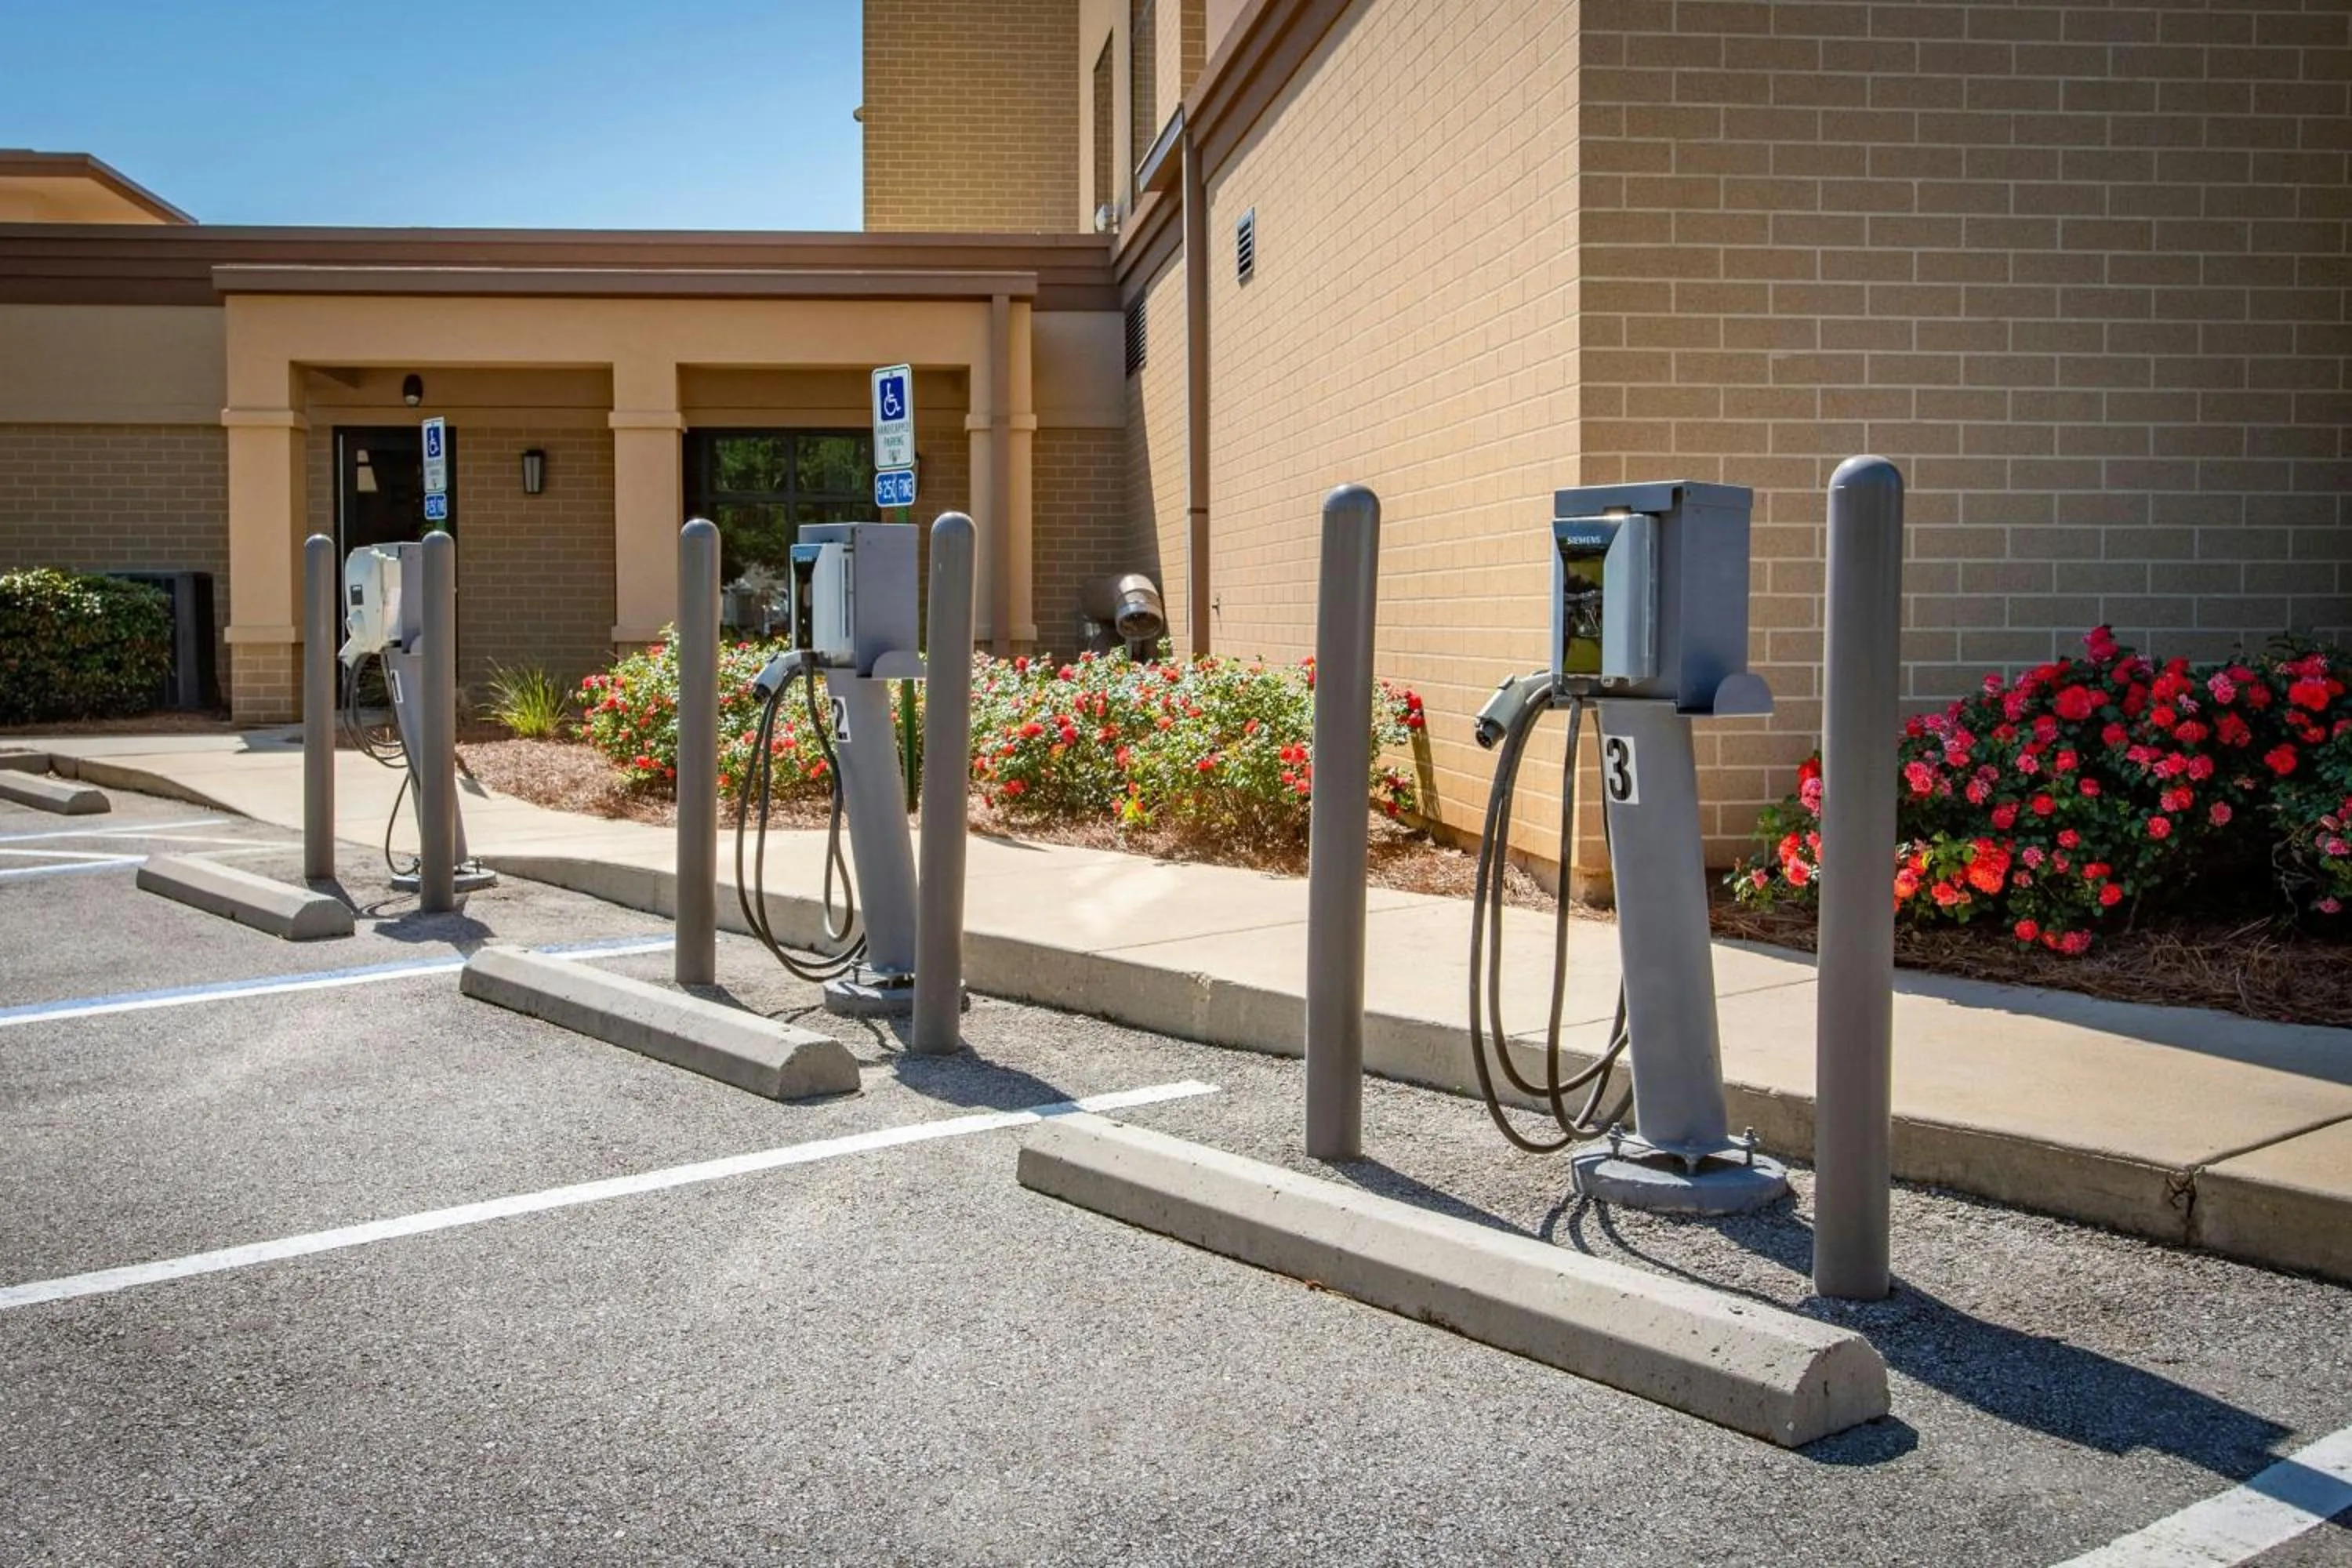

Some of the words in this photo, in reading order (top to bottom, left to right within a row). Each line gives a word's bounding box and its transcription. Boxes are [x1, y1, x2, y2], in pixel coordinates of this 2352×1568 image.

[1567, 536, 1601, 545] SIEMENS
[831, 699, 848, 740] 2
[1606, 738, 1631, 801] 3
